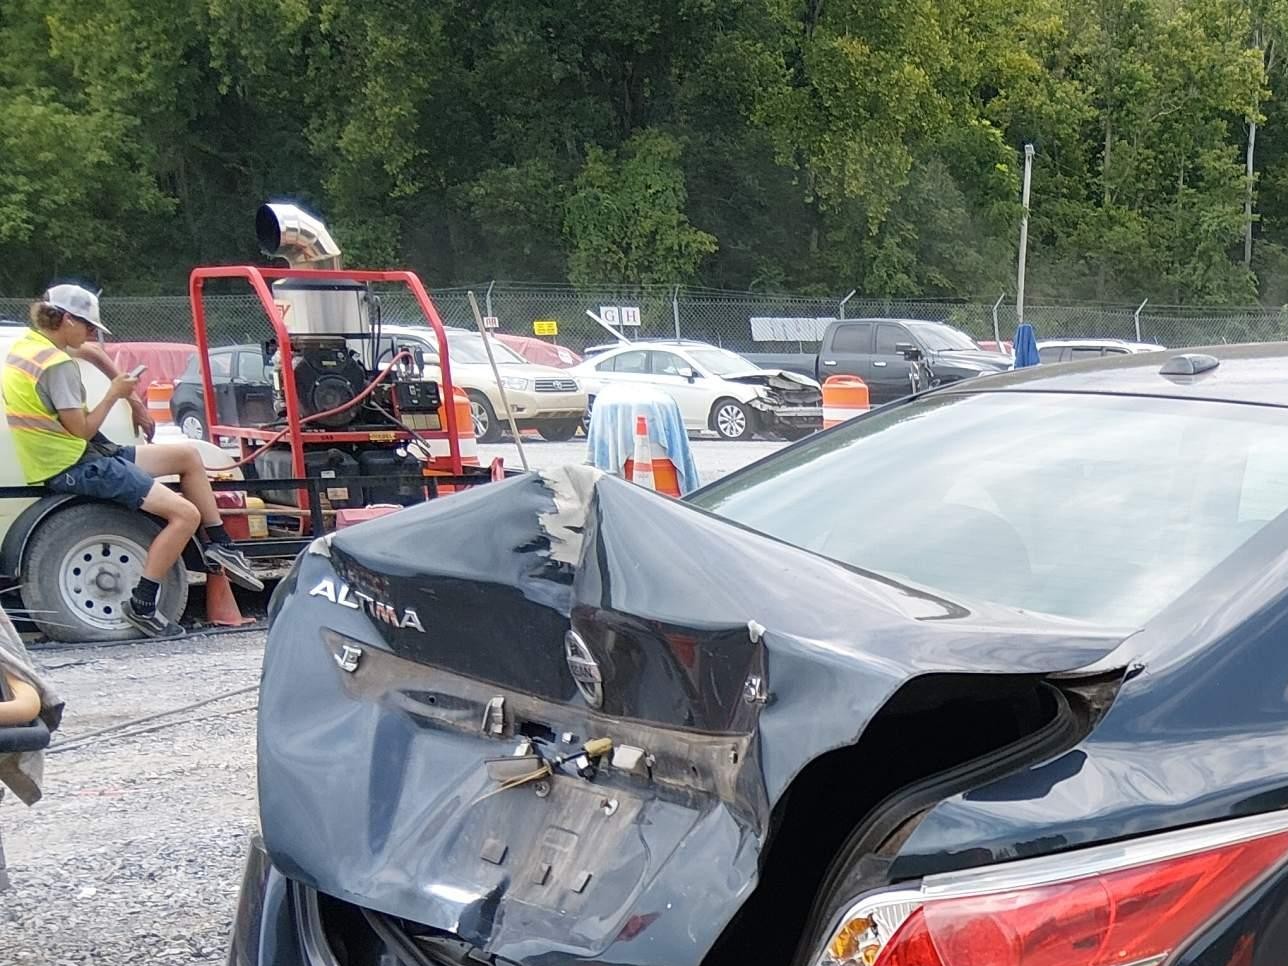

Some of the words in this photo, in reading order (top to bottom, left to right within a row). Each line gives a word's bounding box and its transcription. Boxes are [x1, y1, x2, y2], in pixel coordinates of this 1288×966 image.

[604, 309, 616, 322] G
[626, 310, 637, 323] H
[309, 579, 426, 632] ALTIMA
